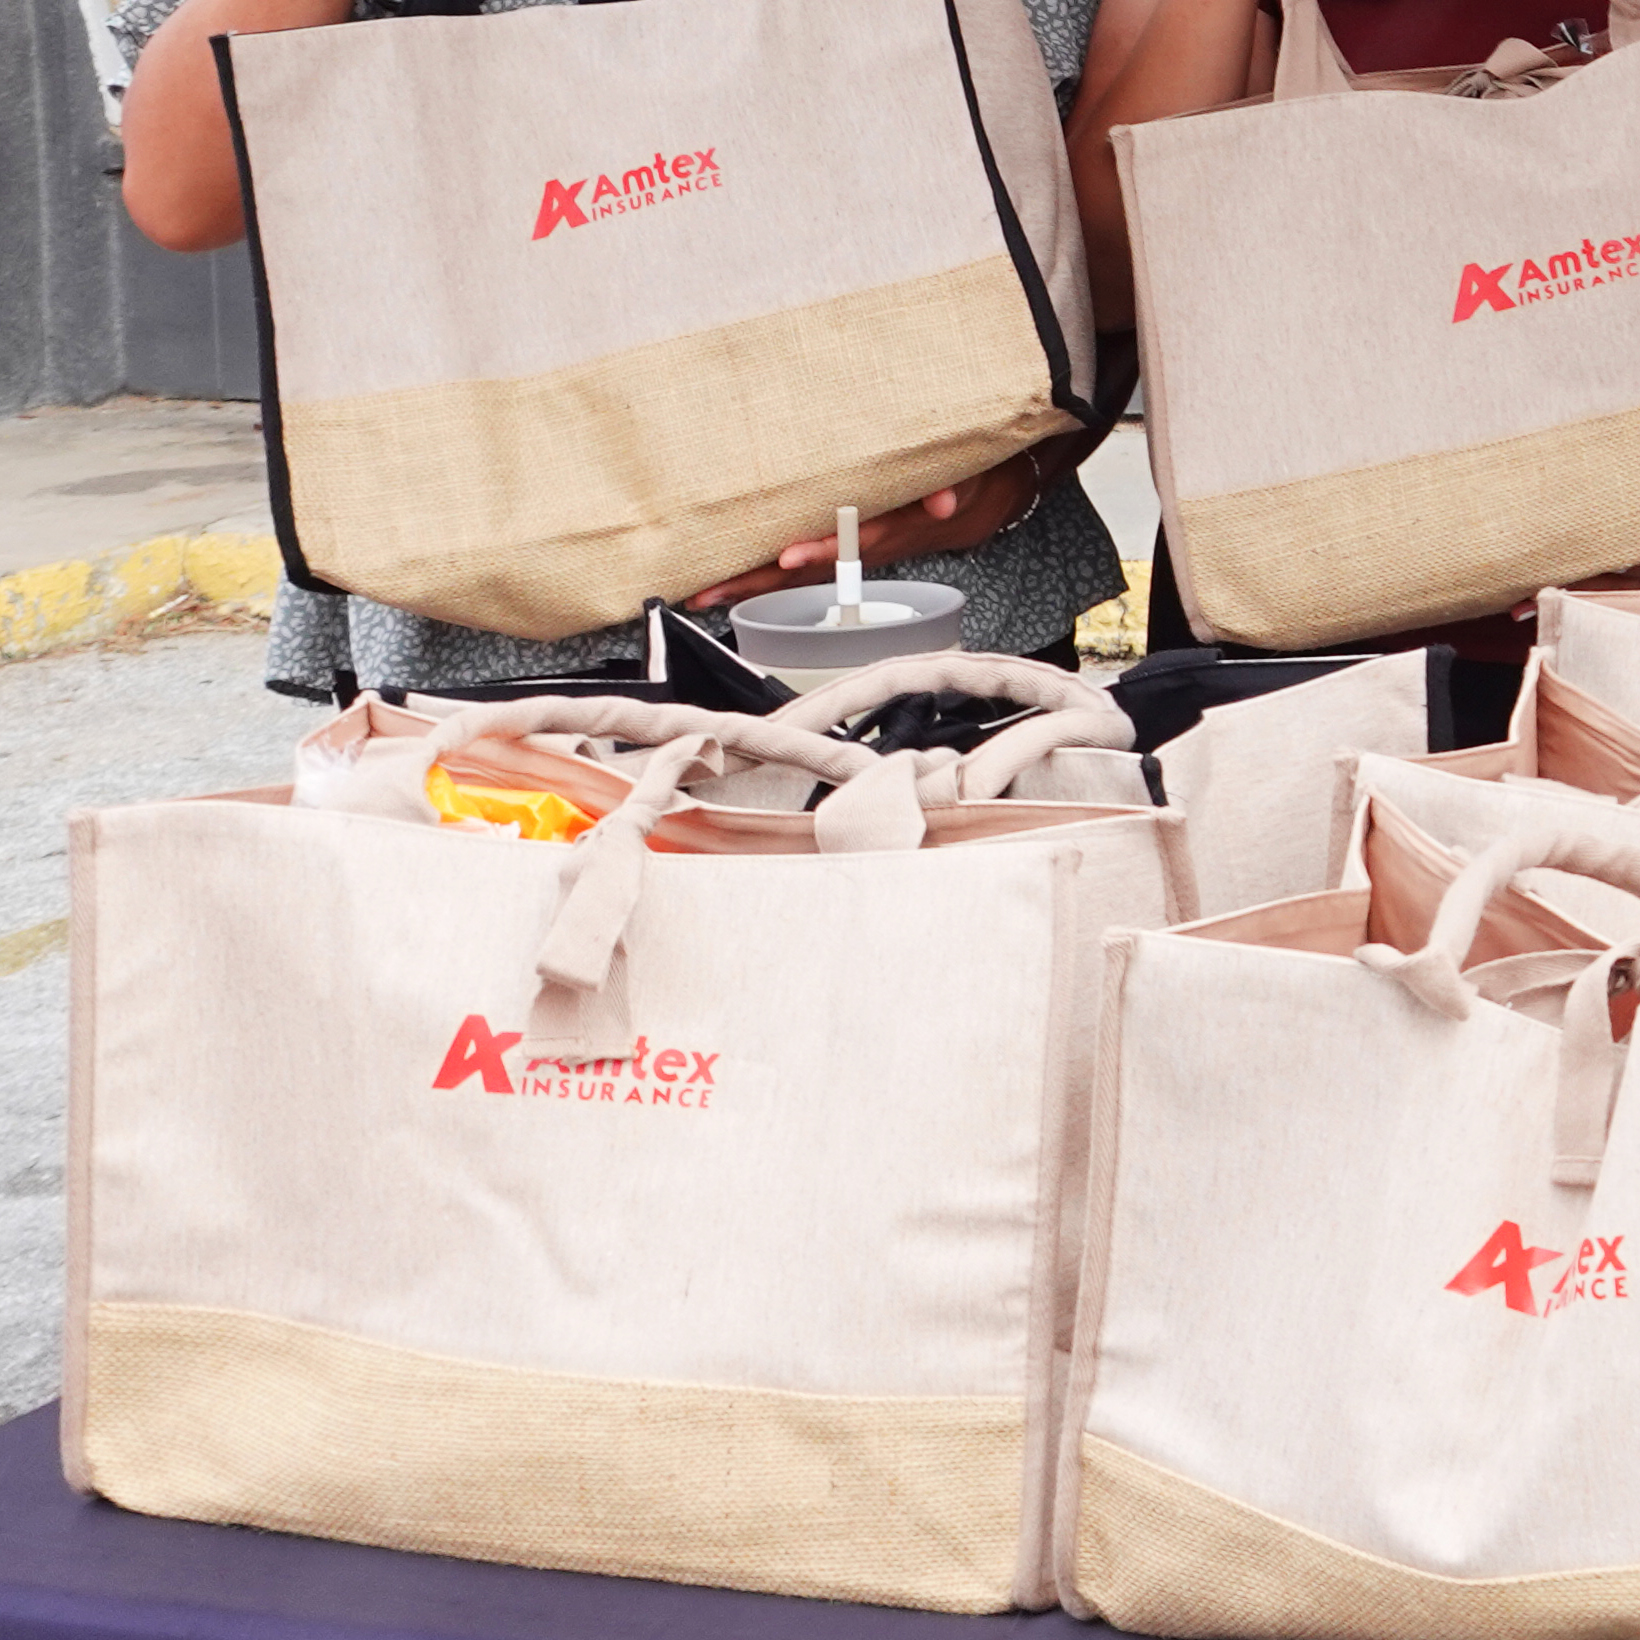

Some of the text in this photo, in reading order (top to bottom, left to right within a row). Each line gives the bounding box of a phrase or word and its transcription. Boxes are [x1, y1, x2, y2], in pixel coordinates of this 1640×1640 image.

[591, 147, 721, 204] Amtex
[592, 173, 723, 221] INSURANCE
[521, 1077, 713, 1109] INSURANCE
